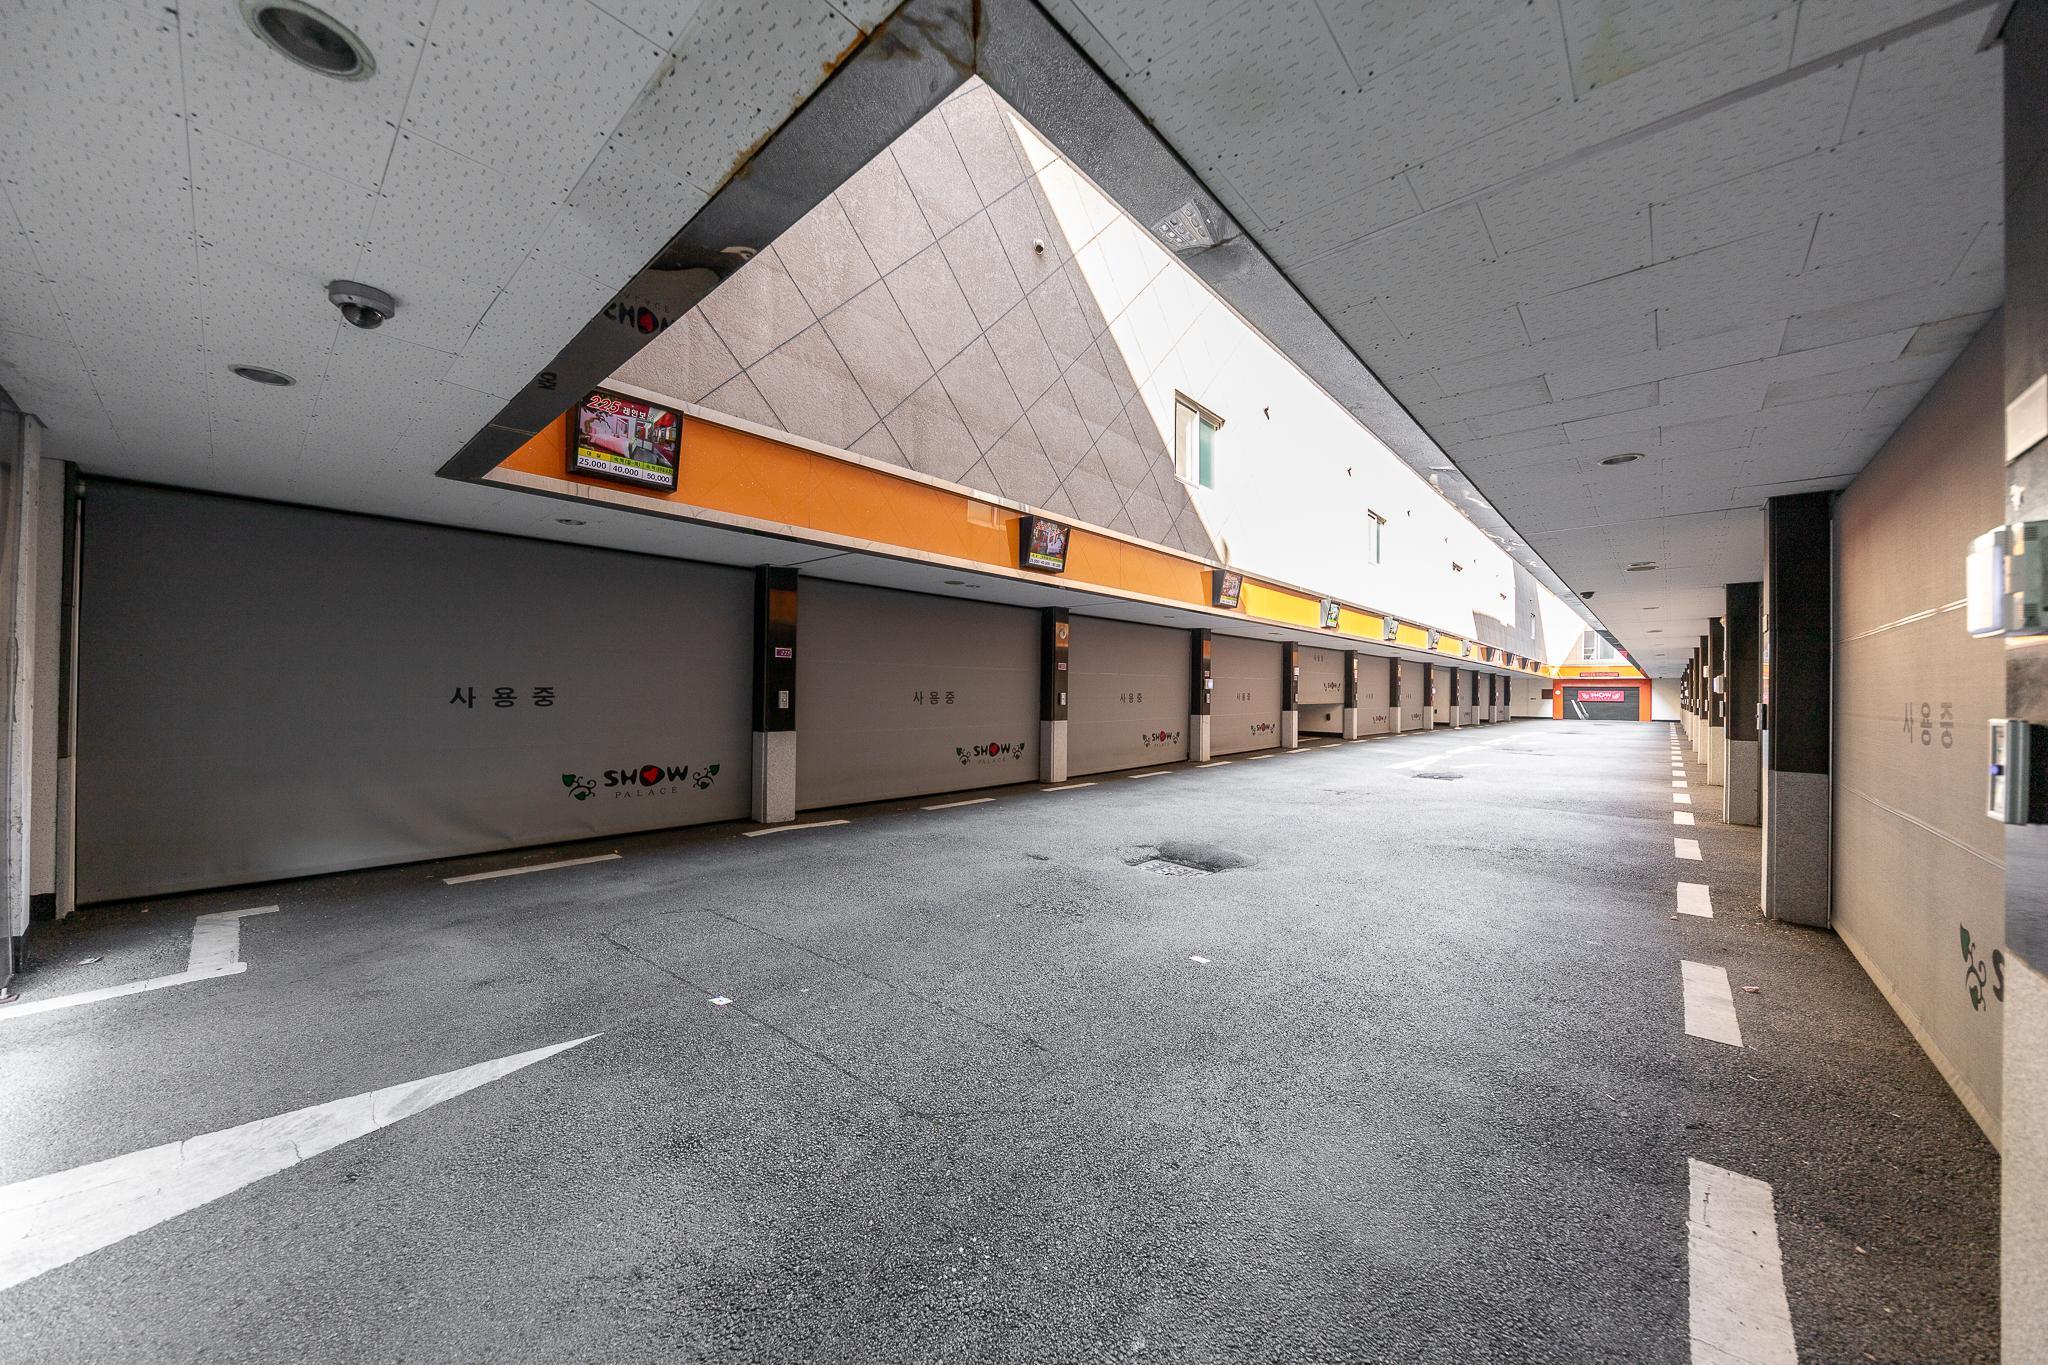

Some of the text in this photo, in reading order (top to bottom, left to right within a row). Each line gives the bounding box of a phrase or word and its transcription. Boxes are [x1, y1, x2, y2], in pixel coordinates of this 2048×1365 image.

[587, 395, 621, 415] 225
[1151, 730, 1173, 743] SHOW
[973, 742, 1011, 758] SHOW
[603, 763, 689, 788] SHOW
[615, 786, 679, 799] PALACE
